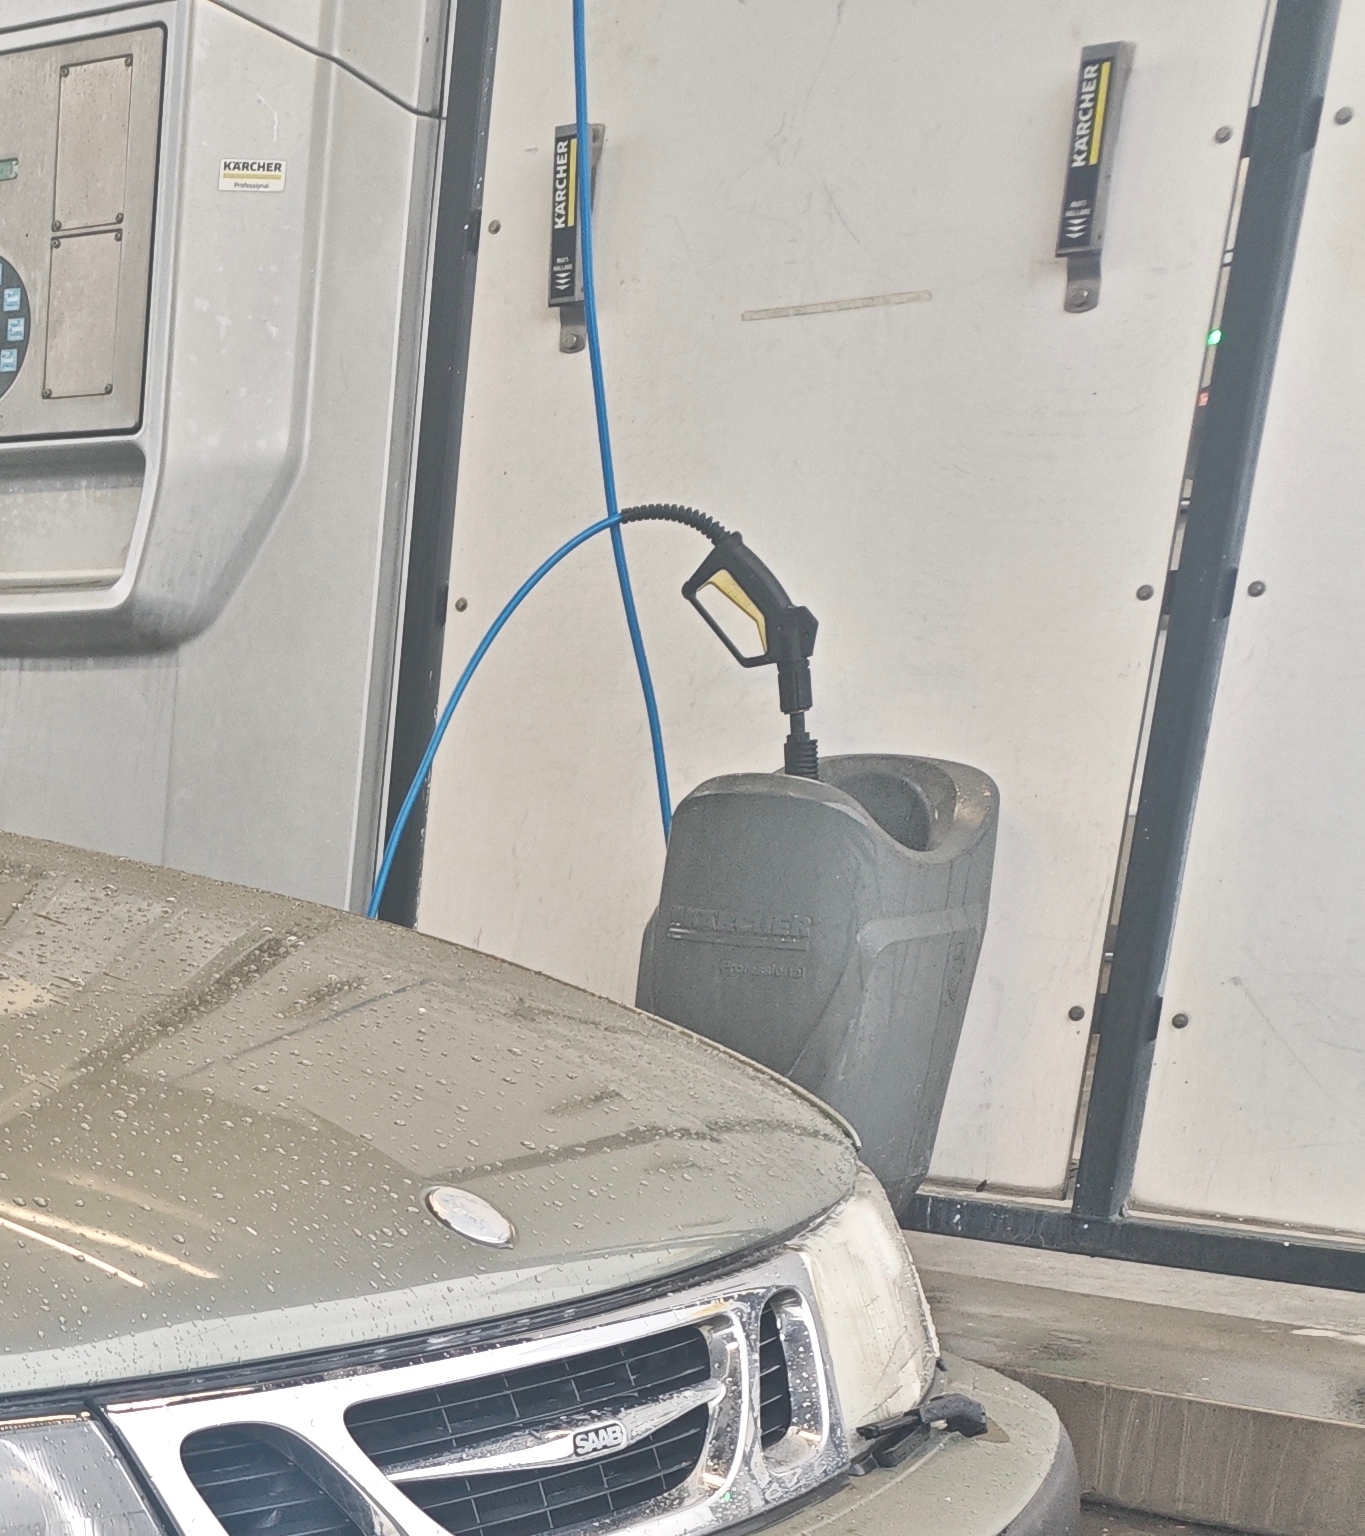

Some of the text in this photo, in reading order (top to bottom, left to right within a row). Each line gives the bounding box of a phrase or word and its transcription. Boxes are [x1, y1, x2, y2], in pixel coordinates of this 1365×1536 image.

[1071, 63, 1100, 168] KÄRCHER
[223, 160, 283, 172] KÄRCHER
[233, 181, 270, 189] Professional
[554, 139, 569, 229] KÄRCHER
[575, 1425, 624, 1455] SAAB
